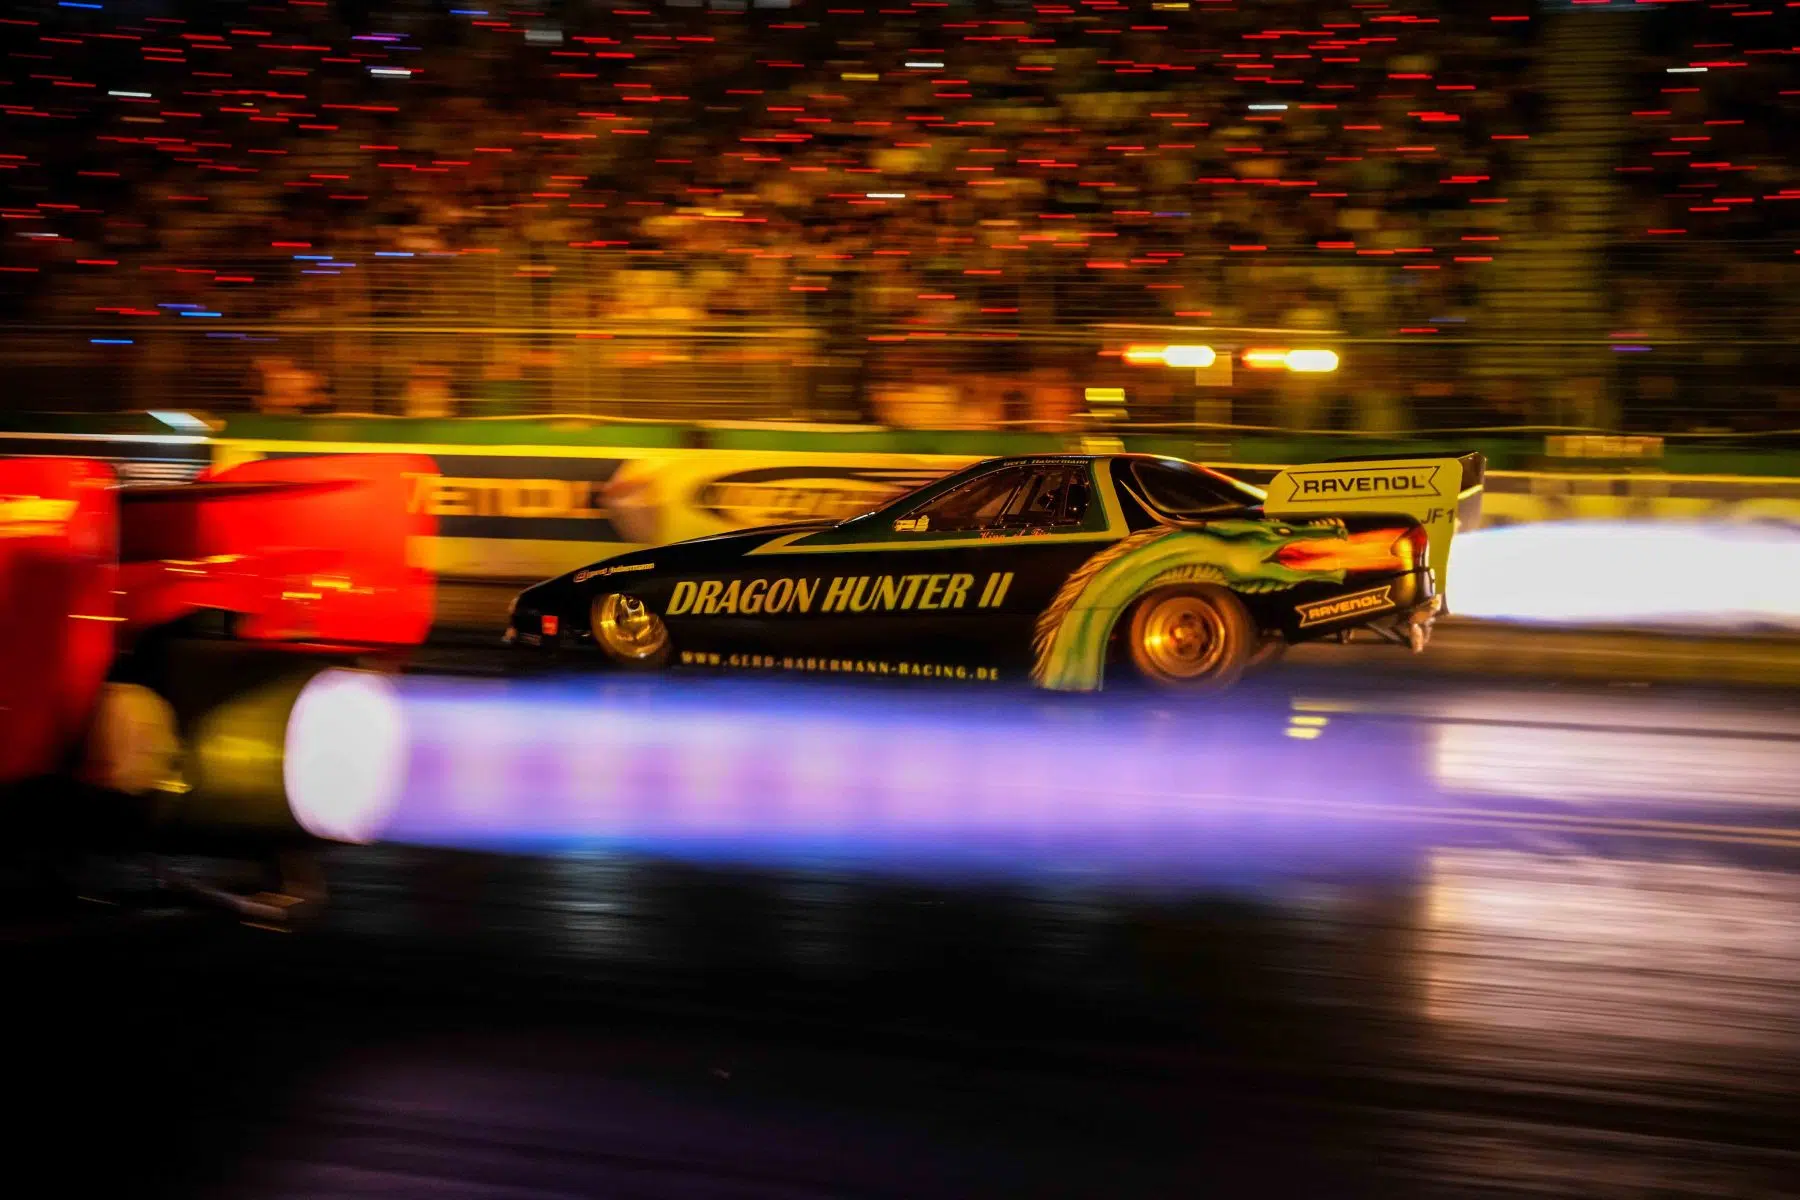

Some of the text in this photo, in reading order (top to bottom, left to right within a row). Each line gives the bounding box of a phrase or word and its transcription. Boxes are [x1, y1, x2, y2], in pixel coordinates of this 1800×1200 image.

[1303, 475, 1425, 494] RAVENOL
[665, 572, 1014, 615] DRAGON HUNTER II
[1308, 595, 1382, 620] RAVENOL
[680, 650, 1000, 681] WWW.GERD-HABERMANN-RACING.DE
